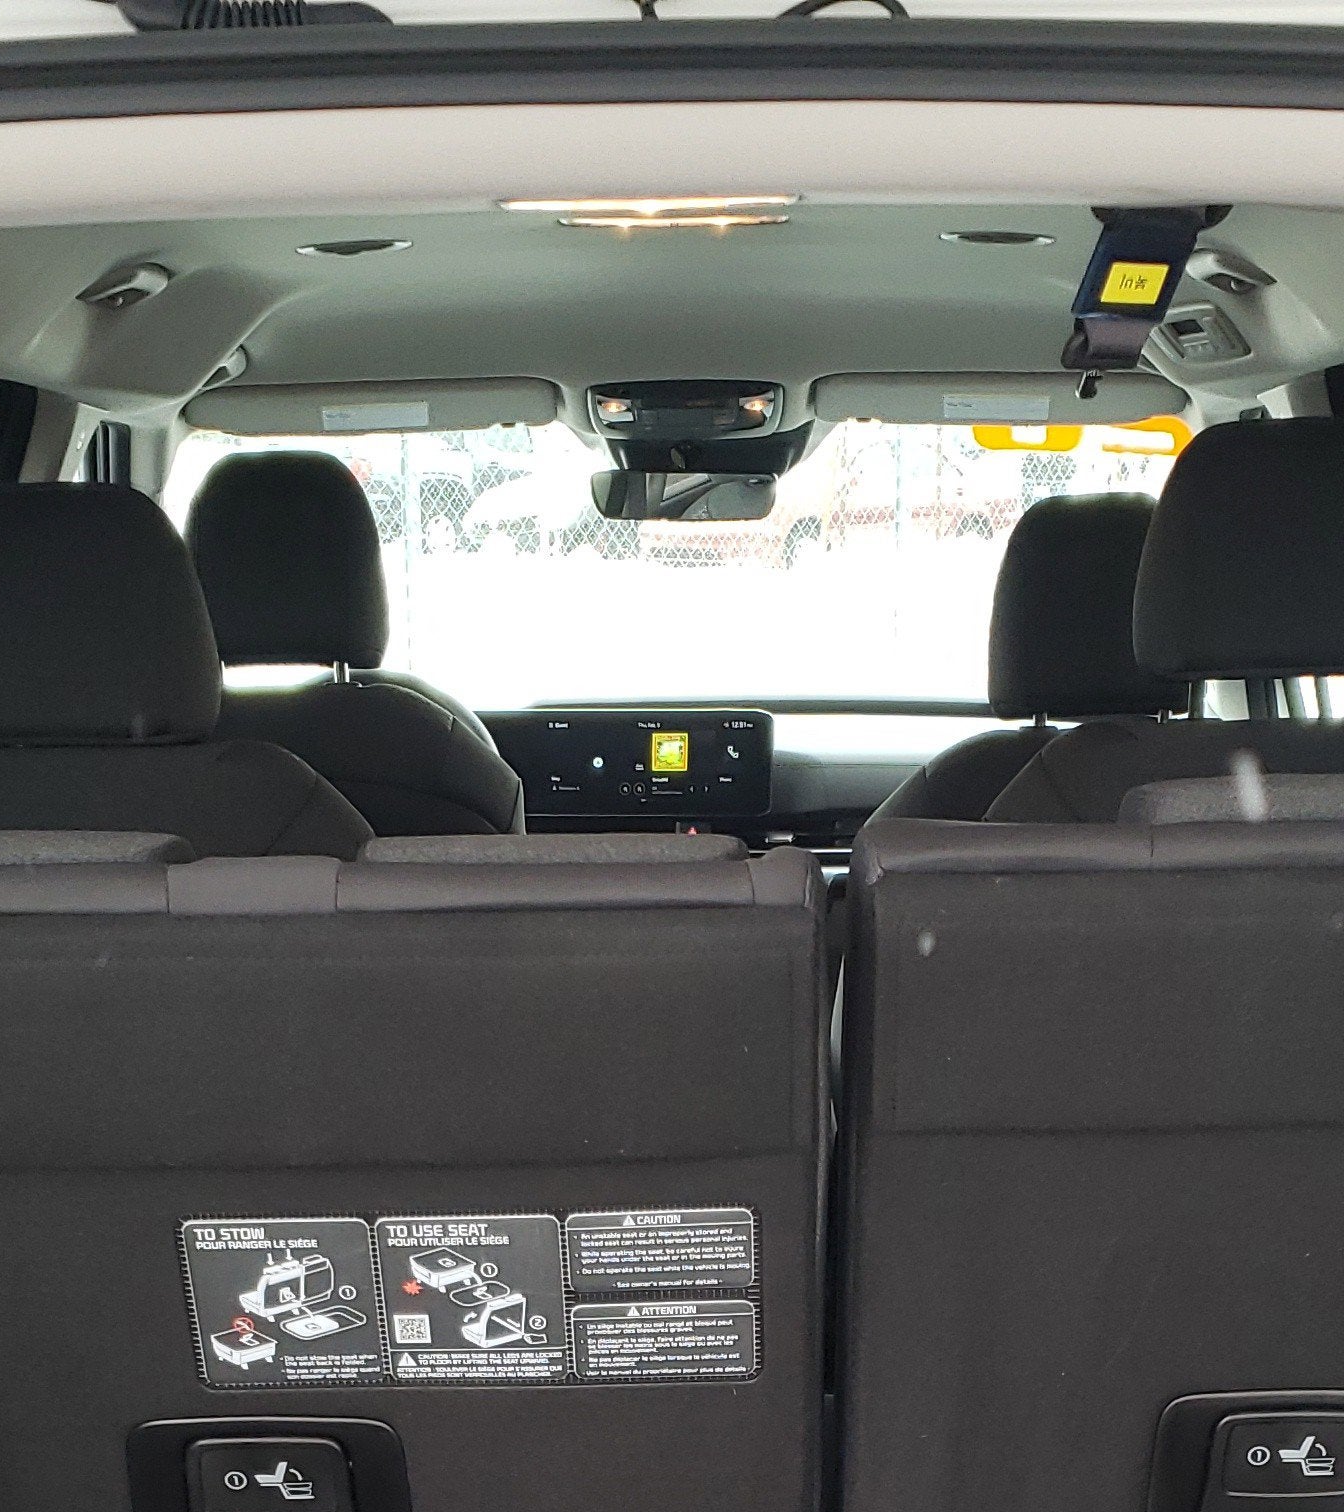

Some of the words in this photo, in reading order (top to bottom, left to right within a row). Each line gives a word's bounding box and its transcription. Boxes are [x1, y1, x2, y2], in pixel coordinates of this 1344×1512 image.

[637, 1215, 681, 1224] CAUTION
[193, 1228, 215, 1240] TO
[220, 1227, 265, 1240] STOW
[385, 1225, 407, 1237] TO
[412, 1224, 443, 1237] USE
[448, 1223, 488, 1237] SEAT
[195, 1241, 226, 1250] POUR
[227, 1240, 272, 1249] RANGER
[273, 1239, 286, 1248] LE
[387, 1237, 418, 1246] POUR
[419, 1237, 464, 1246] UTILISER
[465, 1237, 478, 1245] LE
[642, 1305, 697, 1315] ATTENTION
